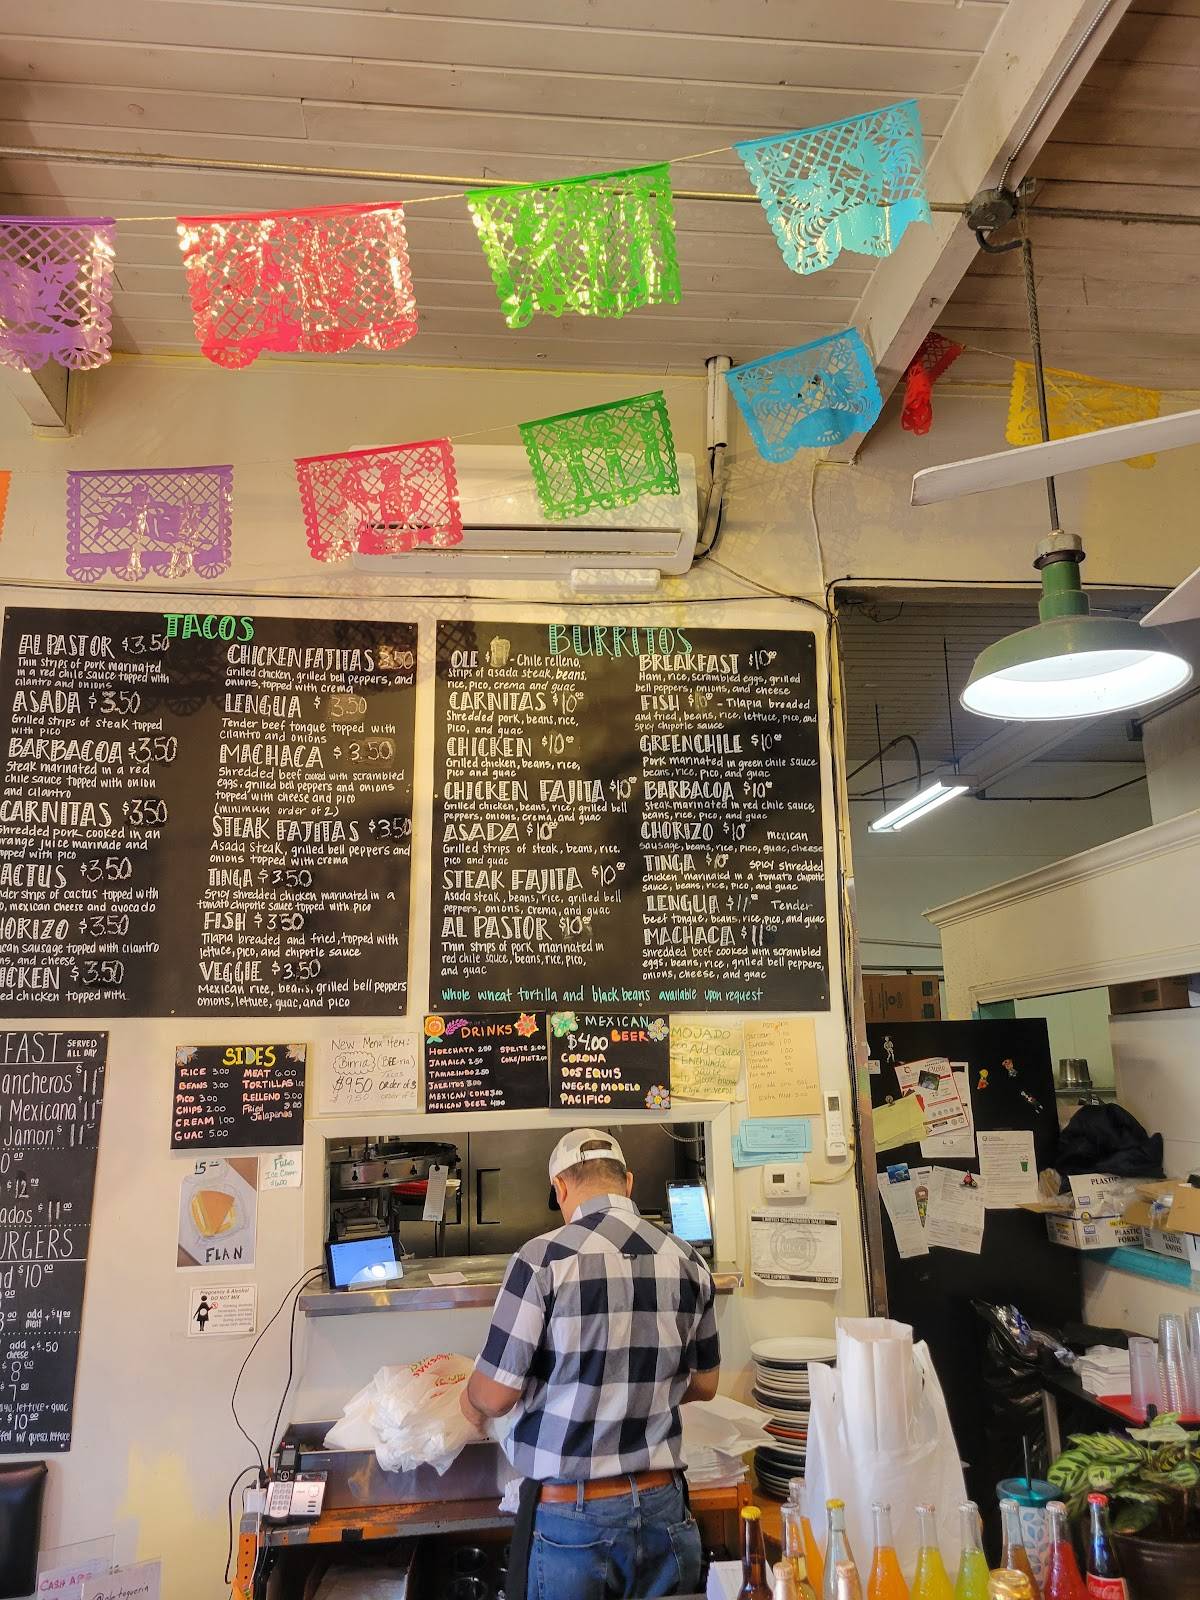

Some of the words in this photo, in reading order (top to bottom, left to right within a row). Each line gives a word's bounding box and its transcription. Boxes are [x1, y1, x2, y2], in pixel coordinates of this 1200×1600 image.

[164, 614, 254, 641] TACOS
[19, 634, 42, 655] AL
[47, 634, 115, 659] PASTOR
[549, 624, 692, 657] BURRITOS
[41, 657, 68, 669] strips
[71, 659, 81, 668] of
[84, 661, 105, 670] pork
[109, 663, 161, 673] marinated
[227, 644, 301, 667] CHICKEN
[305, 648, 374, 671] FAJITAS
[450, 650, 478, 668] OLE
[517, 655, 541, 666] Chile
[639, 654, 739, 675] BREAKFAST
[13, 691, 80, 713] ASADA
[225, 694, 301, 718] LENGUA
[449, 692, 547, 711] CARNITAS
[641, 695, 679, 711] FISH
[726, 698, 762, 708] Tilapia
[769, 700, 810, 709] breaded
[12, 714, 44, 724] Grilled
[48, 716, 76, 727] strips
[96, 719, 129, 730] steak
[132, 721, 162, 731] topped
[447, 711, 493, 722] Shredded
[40, 728, 60, 736] pico
[222, 719, 258, 728] Tender
[262, 720, 285, 730] beef
[290, 722, 326, 737] tongue
[332, 723, 364, 733] topped
[371, 724, 395, 734] with
[265, 732, 285, 741] and
[292, 734, 327, 744] onions
[9, 738, 122, 764] BARBACOA
[447, 737, 531, 757] CHICKEN
[219, 744, 323, 768] MACHACA
[444, 781, 528, 801] CHICKEN
[540, 780, 605, 804] FAJITA
[645, 781, 734, 802] BARBACOA
[0, 800, 112, 827] CARNITAS
[213, 815, 270, 839] STEAK
[277, 820, 359, 842] FAJITAS
[443, 823, 519, 842] ASADA
[641, 821, 713, 841] CHORIZO
[644, 854, 696, 874] TINGA
[208, 868, 252, 889] TINGA
[442, 870, 504, 890] STEAK
[512, 867, 583, 894] FAJITA
[647, 895, 720, 914] LENGUA
[771, 900, 813, 911] Tender
[204, 912, 246, 930] FISH
[442, 916, 467, 938] AL
[474, 916, 552, 940] PASTOR
[202, 934, 233, 944] Tilapia
[239, 934, 280, 945] breaded
[287, 935, 305, 945] and
[341, 933, 373, 945] topped
[377, 935, 398, 945] with
[644, 926, 735, 946] MACHACA
[261, 947, 280, 957] and
[285, 947, 325, 958] chipotle
[329, 948, 361, 957] sauce
[692, 948, 713, 956] beef
[717, 948, 748, 956] cooked
[773, 946, 821, 957] scrambled
[199, 961, 262, 983] VEGGIE
[478, 989, 512, 1001] wheat
[517, 987, 557, 1001] tortilla
[563, 985, 584, 1001] and
[592, 985, 619, 1001] black
[622, 987, 650, 1001] beans
[659, 987, 697, 1000] available
[704, 989, 723, 1001] upon
[725, 986, 764, 1001] request
[585, 1016, 649, 1027] MEXICAN
[461, 1024, 512, 1038] DRINKS
[611, 1029, 648, 1042] BEER
[671, 1028, 731, 1040] MOJADO
[67, 1040, 97, 1048] SERVED
[84, 1048, 97, 1057] DAY
[332, 1040, 354, 1050] New
[567, 1033, 608, 1051] $4.00
[223, 1046, 276, 1067] SIDES
[429, 1047, 474, 1055] HORCHATA
[561, 1053, 606, 1063] CORONA
[339, 1056, 370, 1068] Birria
[429, 1058, 465, 1067] JAMAICA
[181, 1068, 206, 1077] RICE
[244, 1069, 271, 1078] MEAT
[429, 1070, 474, 1078] TAMARINDO
[562, 1067, 583, 1077] DOS
[586, 1068, 621, 1079] EQUIS
[242, 1079, 293, 1089] TORTILLAS
[429, 1081, 464, 1090] JARRITOS
[562, 1082, 598, 1092] NEGRO
[601, 1083, 640, 1091] MODELO
[243, 1093, 280, 1102] RELLENO
[429, 1091, 465, 1100] MEXICAN
[560, 1093, 611, 1105] PACIFICO
[10, 1099, 76, 1122] Mexicana
[429, 1102, 461, 1110] MEXICAN
[176, 1117, 214, 1127] CREAM
[4, 1125, 54, 1147] Jamon
[175, 1131, 203, 1141] GUAC
[205, 1246, 242, 1263] FLAN
[9, 1340, 26, 1350] add
